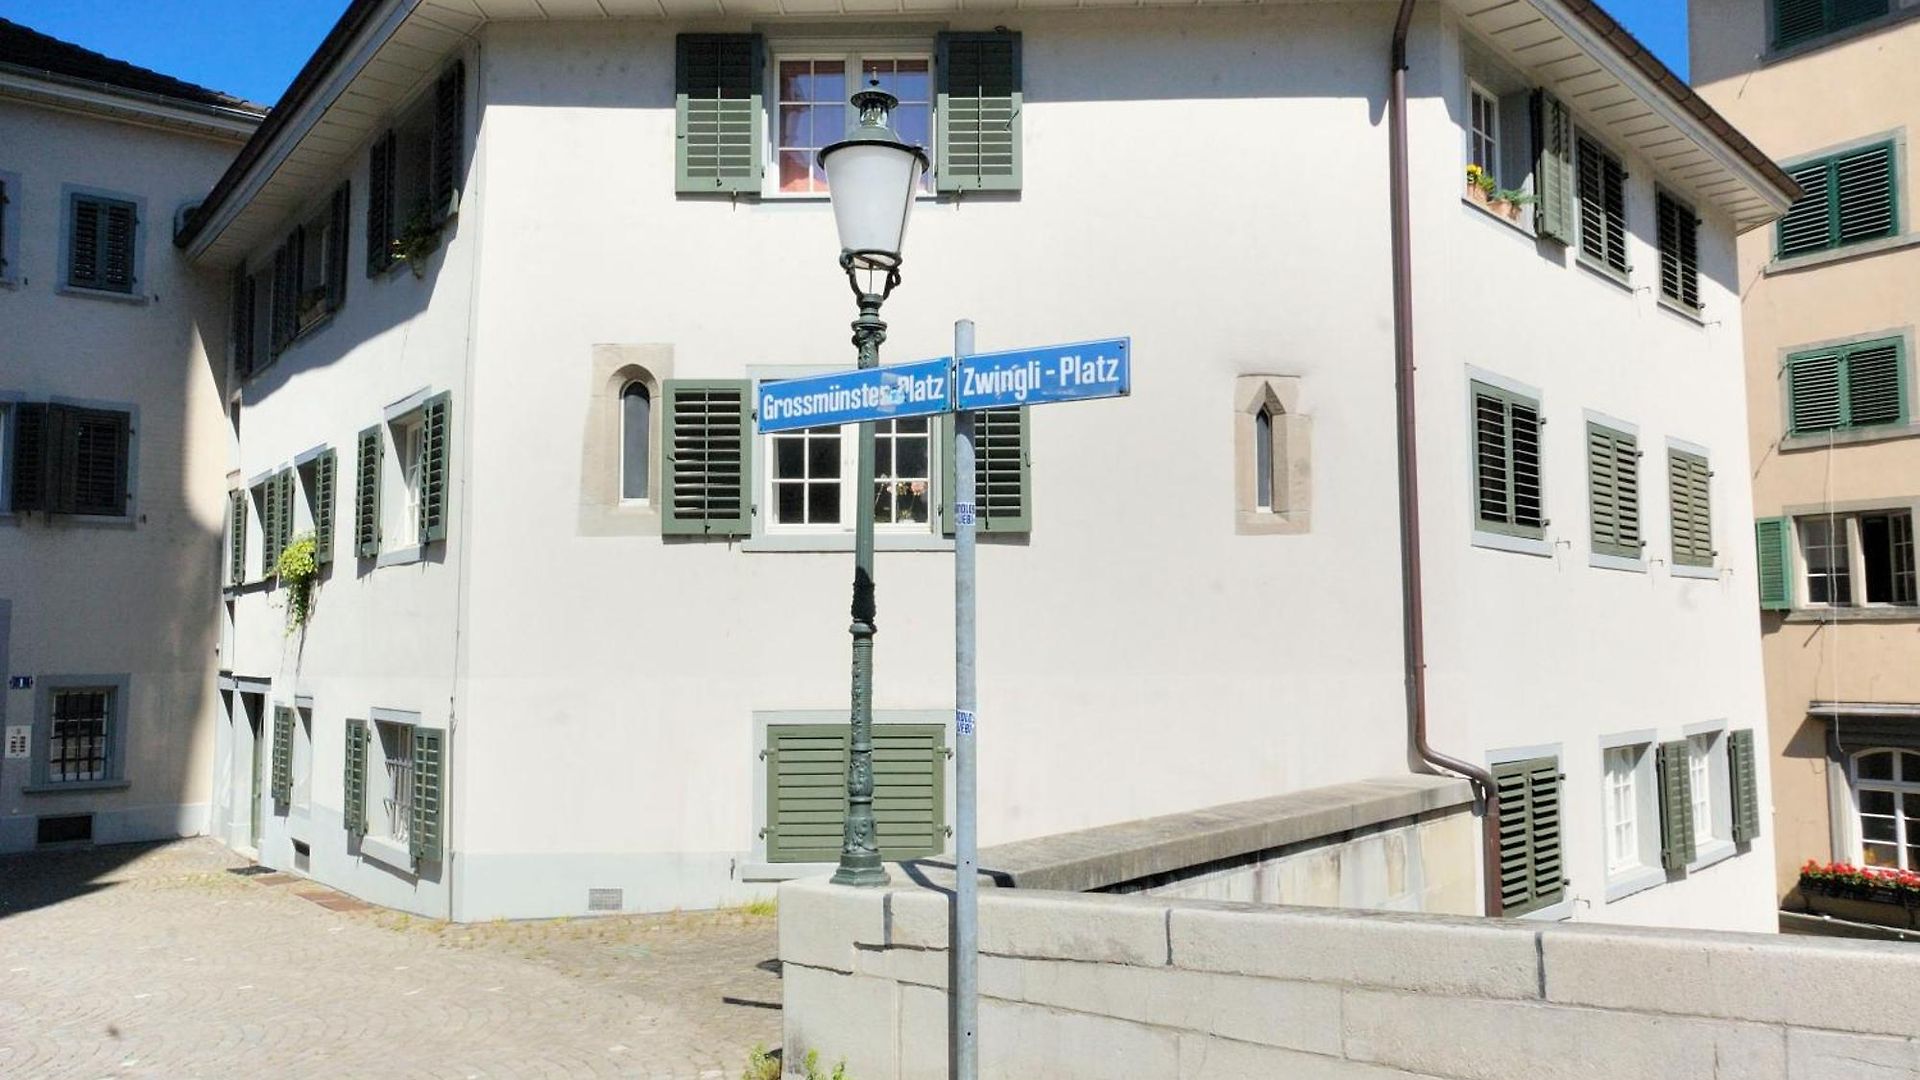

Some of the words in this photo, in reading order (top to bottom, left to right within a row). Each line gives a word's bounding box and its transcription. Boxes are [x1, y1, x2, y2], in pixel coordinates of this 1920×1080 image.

[763, 374, 945, 421] GrossmünsterPlatz
[963, 360, 1041, 401] Zwingli
[1060, 355, 1119, 387] Platz
